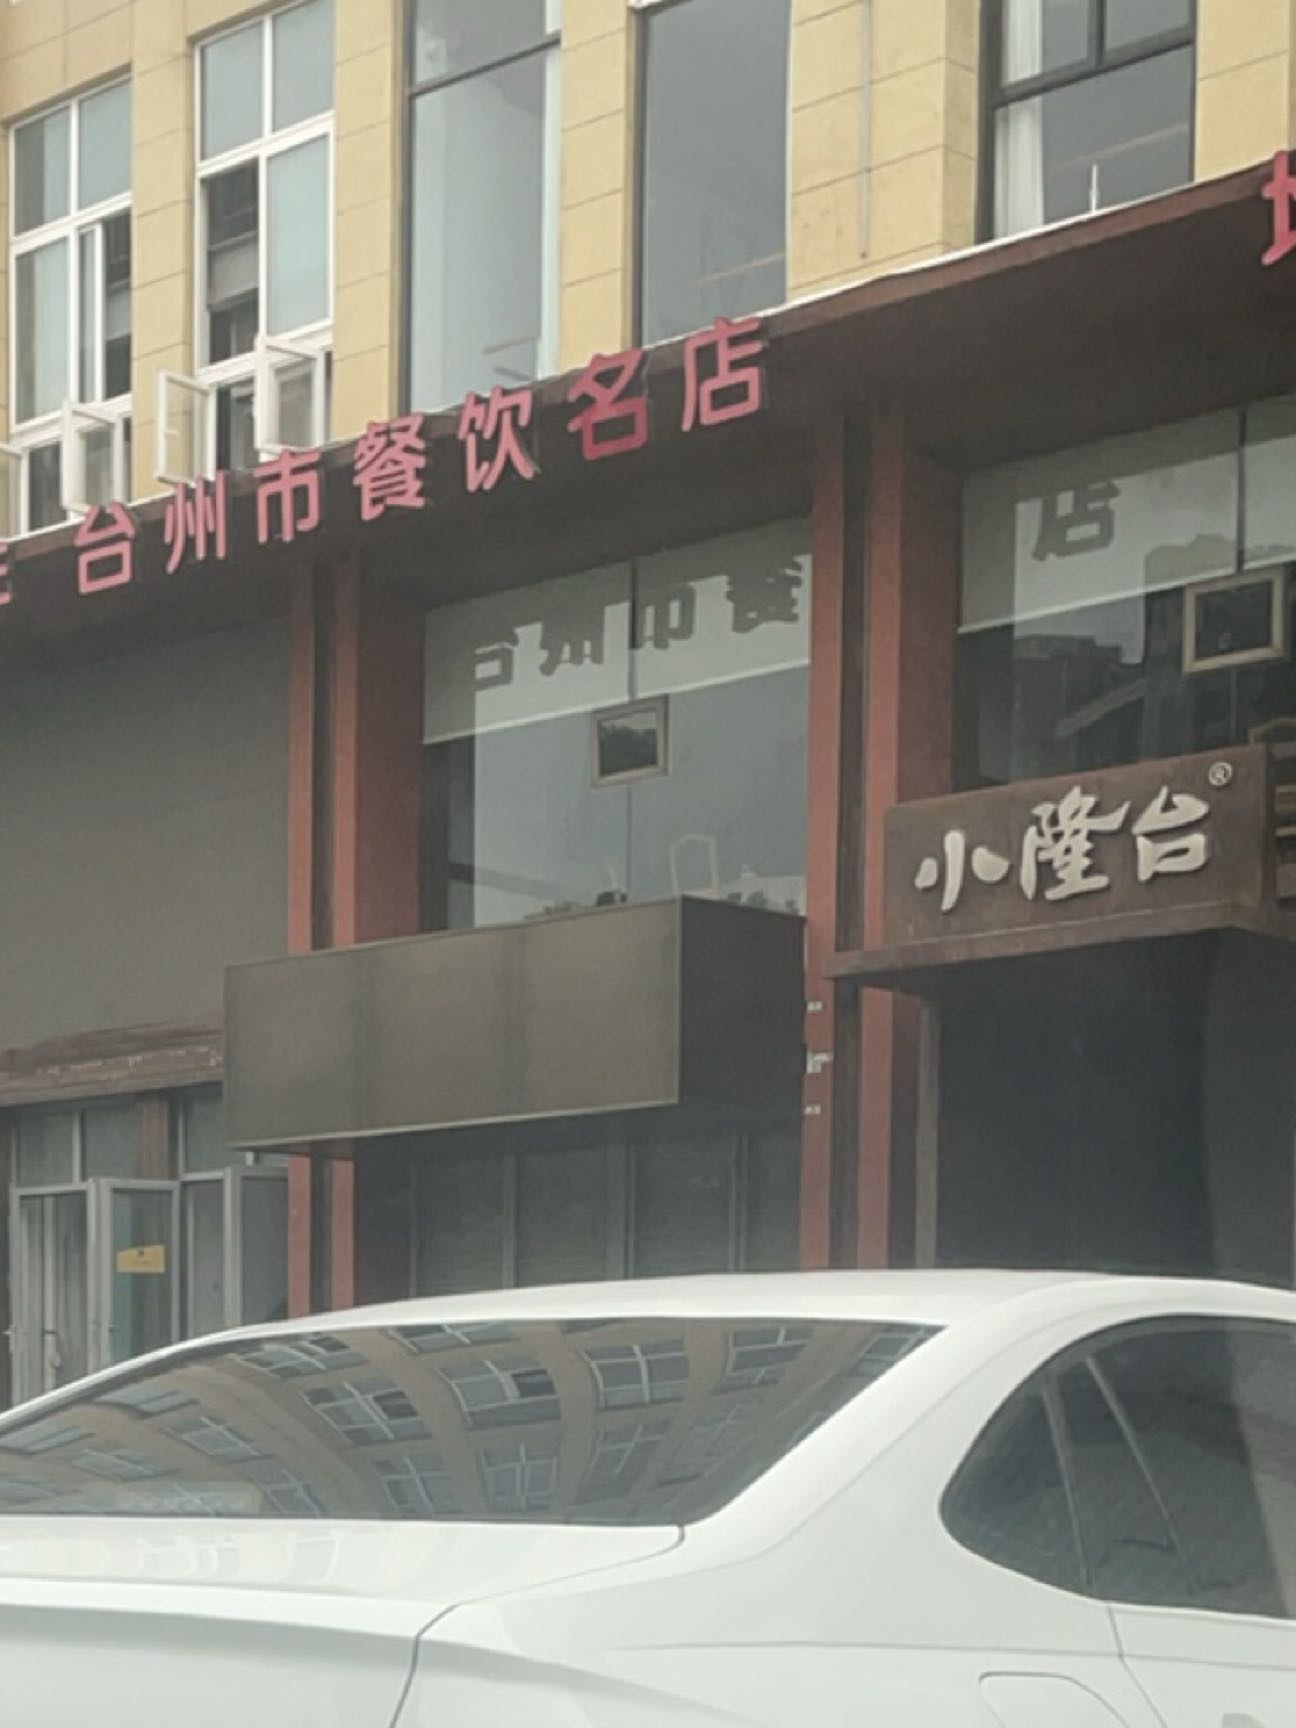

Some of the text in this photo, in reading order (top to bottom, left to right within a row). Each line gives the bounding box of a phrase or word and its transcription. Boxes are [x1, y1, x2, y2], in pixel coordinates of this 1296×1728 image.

[73, 316, 767, 596] 台州市餐饮名店
[913, 785, 1209, 911] 小隆台
